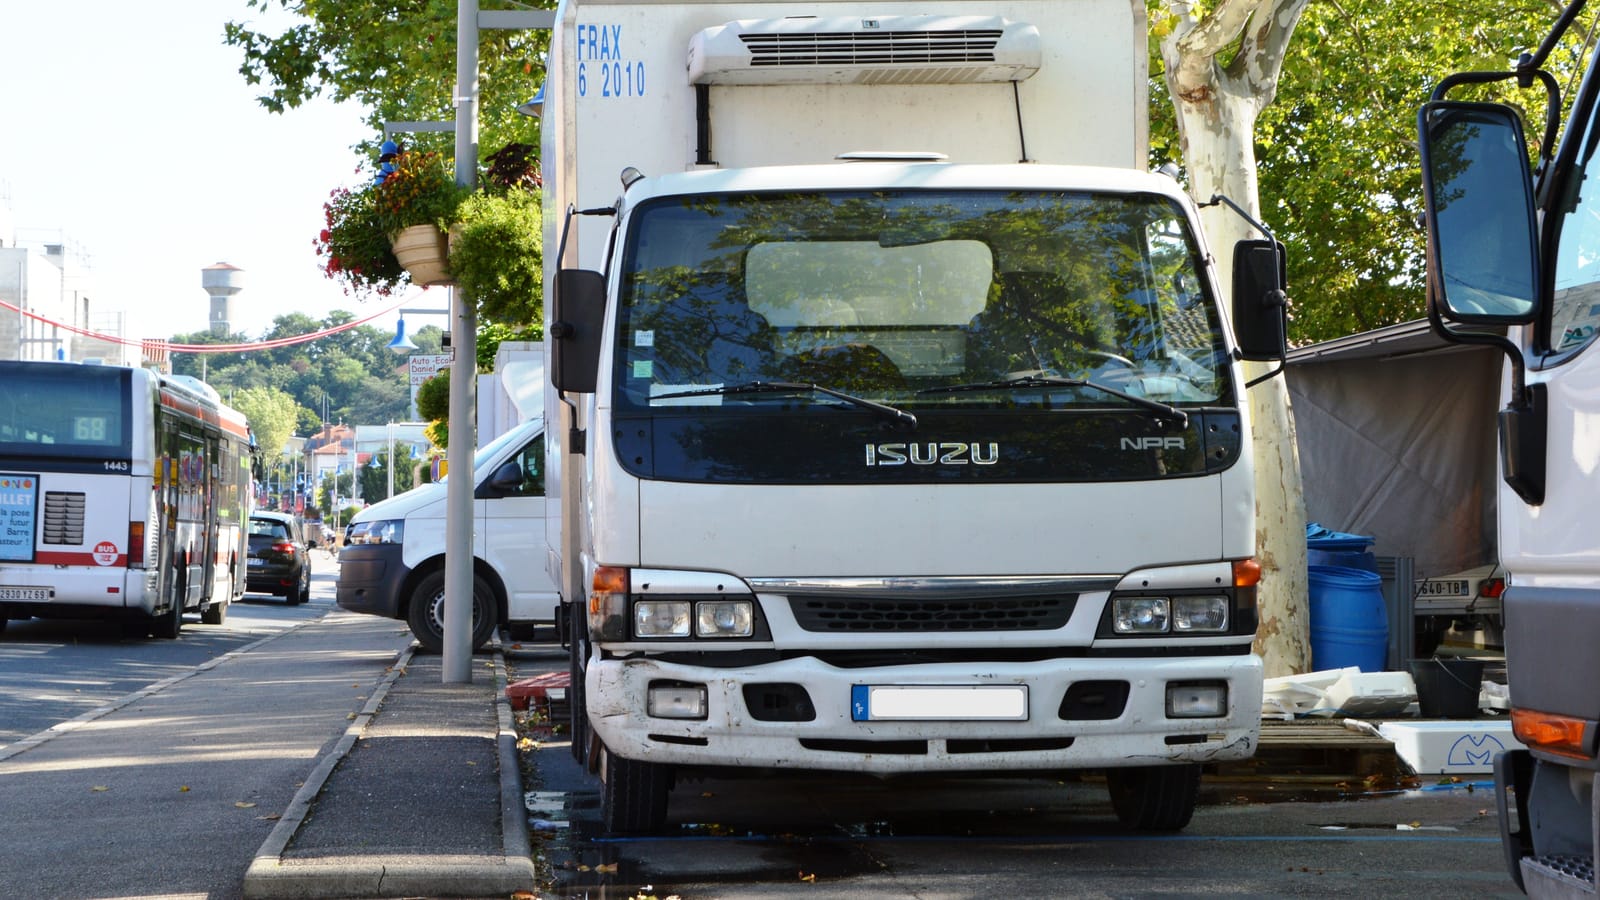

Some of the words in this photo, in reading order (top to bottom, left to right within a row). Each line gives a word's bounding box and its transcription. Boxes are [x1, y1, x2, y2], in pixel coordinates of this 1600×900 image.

[578, 24, 621, 60] FRAX
[578, 62, 586, 97] 6
[602, 61, 645, 97] 2010
[1120, 437, 1185, 450] NPR
[865, 442, 998, 466] ISUZU
[104, 461, 128, 471] 1443
[11, 510, 30, 518] pose
[7, 528, 29, 536] Barre
[98, 545, 114, 553] BUS
